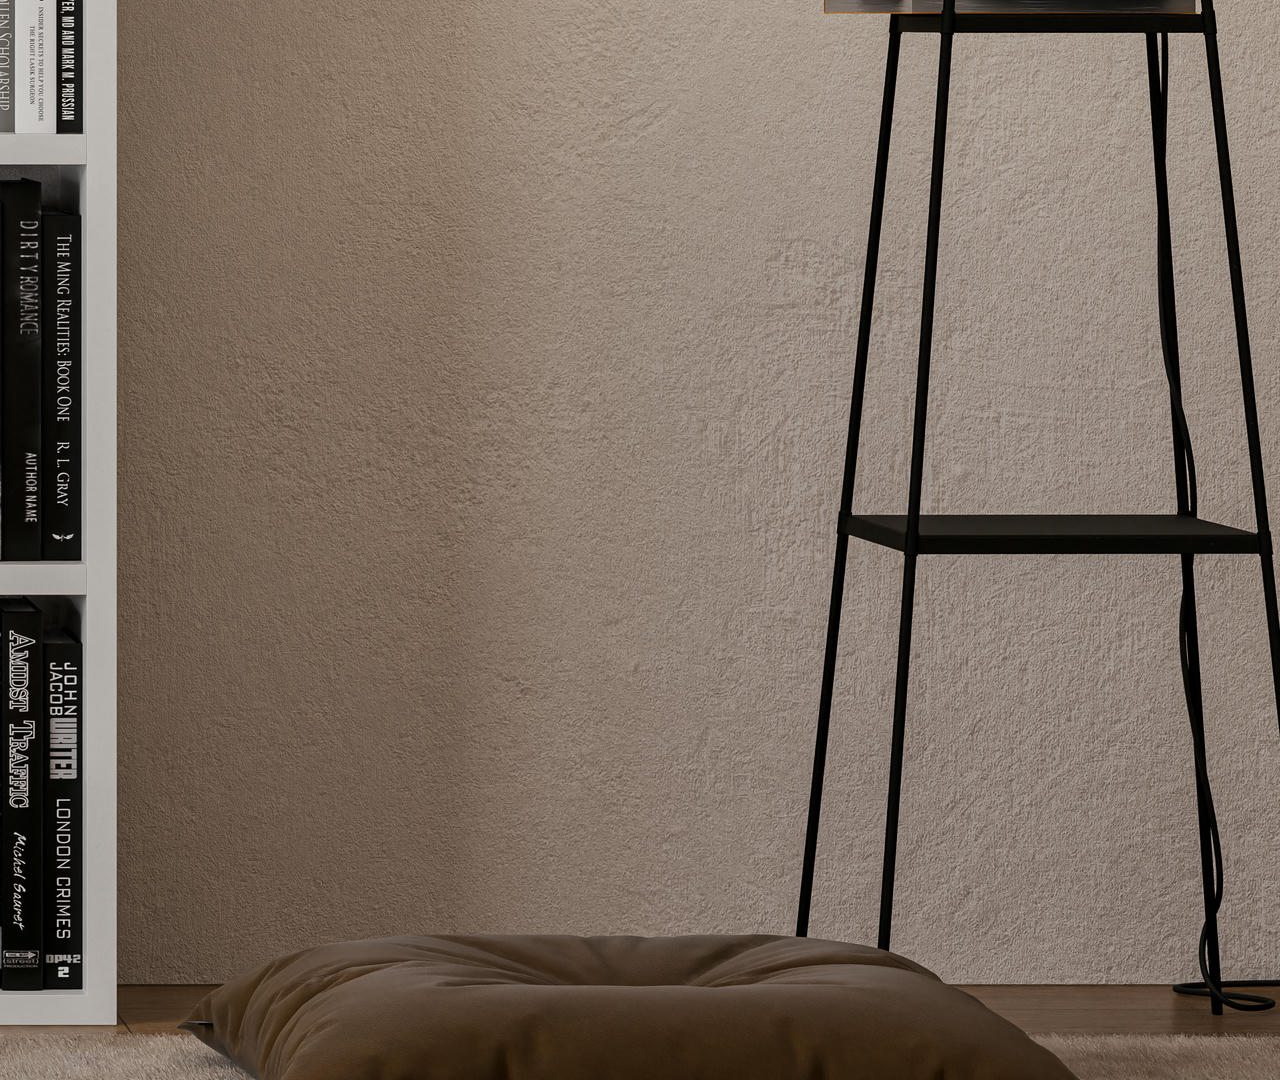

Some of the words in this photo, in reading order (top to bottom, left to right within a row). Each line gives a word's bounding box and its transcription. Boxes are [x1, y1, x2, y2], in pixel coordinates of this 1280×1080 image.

[61, 16, 75, 28] MD
[61, 31, 75, 45] AND
[61, 48, 75, 69] MARK
[61, 71, 75, 81] M.
[61, 83, 75, 121] PRUSSIAN
[20, 220, 38, 274] DIRTY
[57, 234, 72, 257] THE
[57, 260, 72, 295] MING
[20, 276, 38, 335] ROMANCE
[57, 299, 72, 356] REALITIES:
[57, 360, 72, 395] BOOK
[57, 397, 72, 422] ONE
[57, 441, 69, 455] R.
[57, 457, 68, 468] L.
[25, 453, 37, 492] AUTHOR
[57, 470, 69, 506] GRAY
[25, 495, 37, 522] NAME
[9, 630, 35, 712] AMIDST
[50, 663, 63, 715] JACOB
[64, 663, 77, 715] JOHN
[9, 720, 35, 809] TRAFFIC
[50, 718, 77, 780] WRITER
[57, 798, 71, 869] LONDON
[13, 831, 27, 880] Michel
[57, 876, 71, 939] CRIMES
[58, 966, 69, 978] 2
